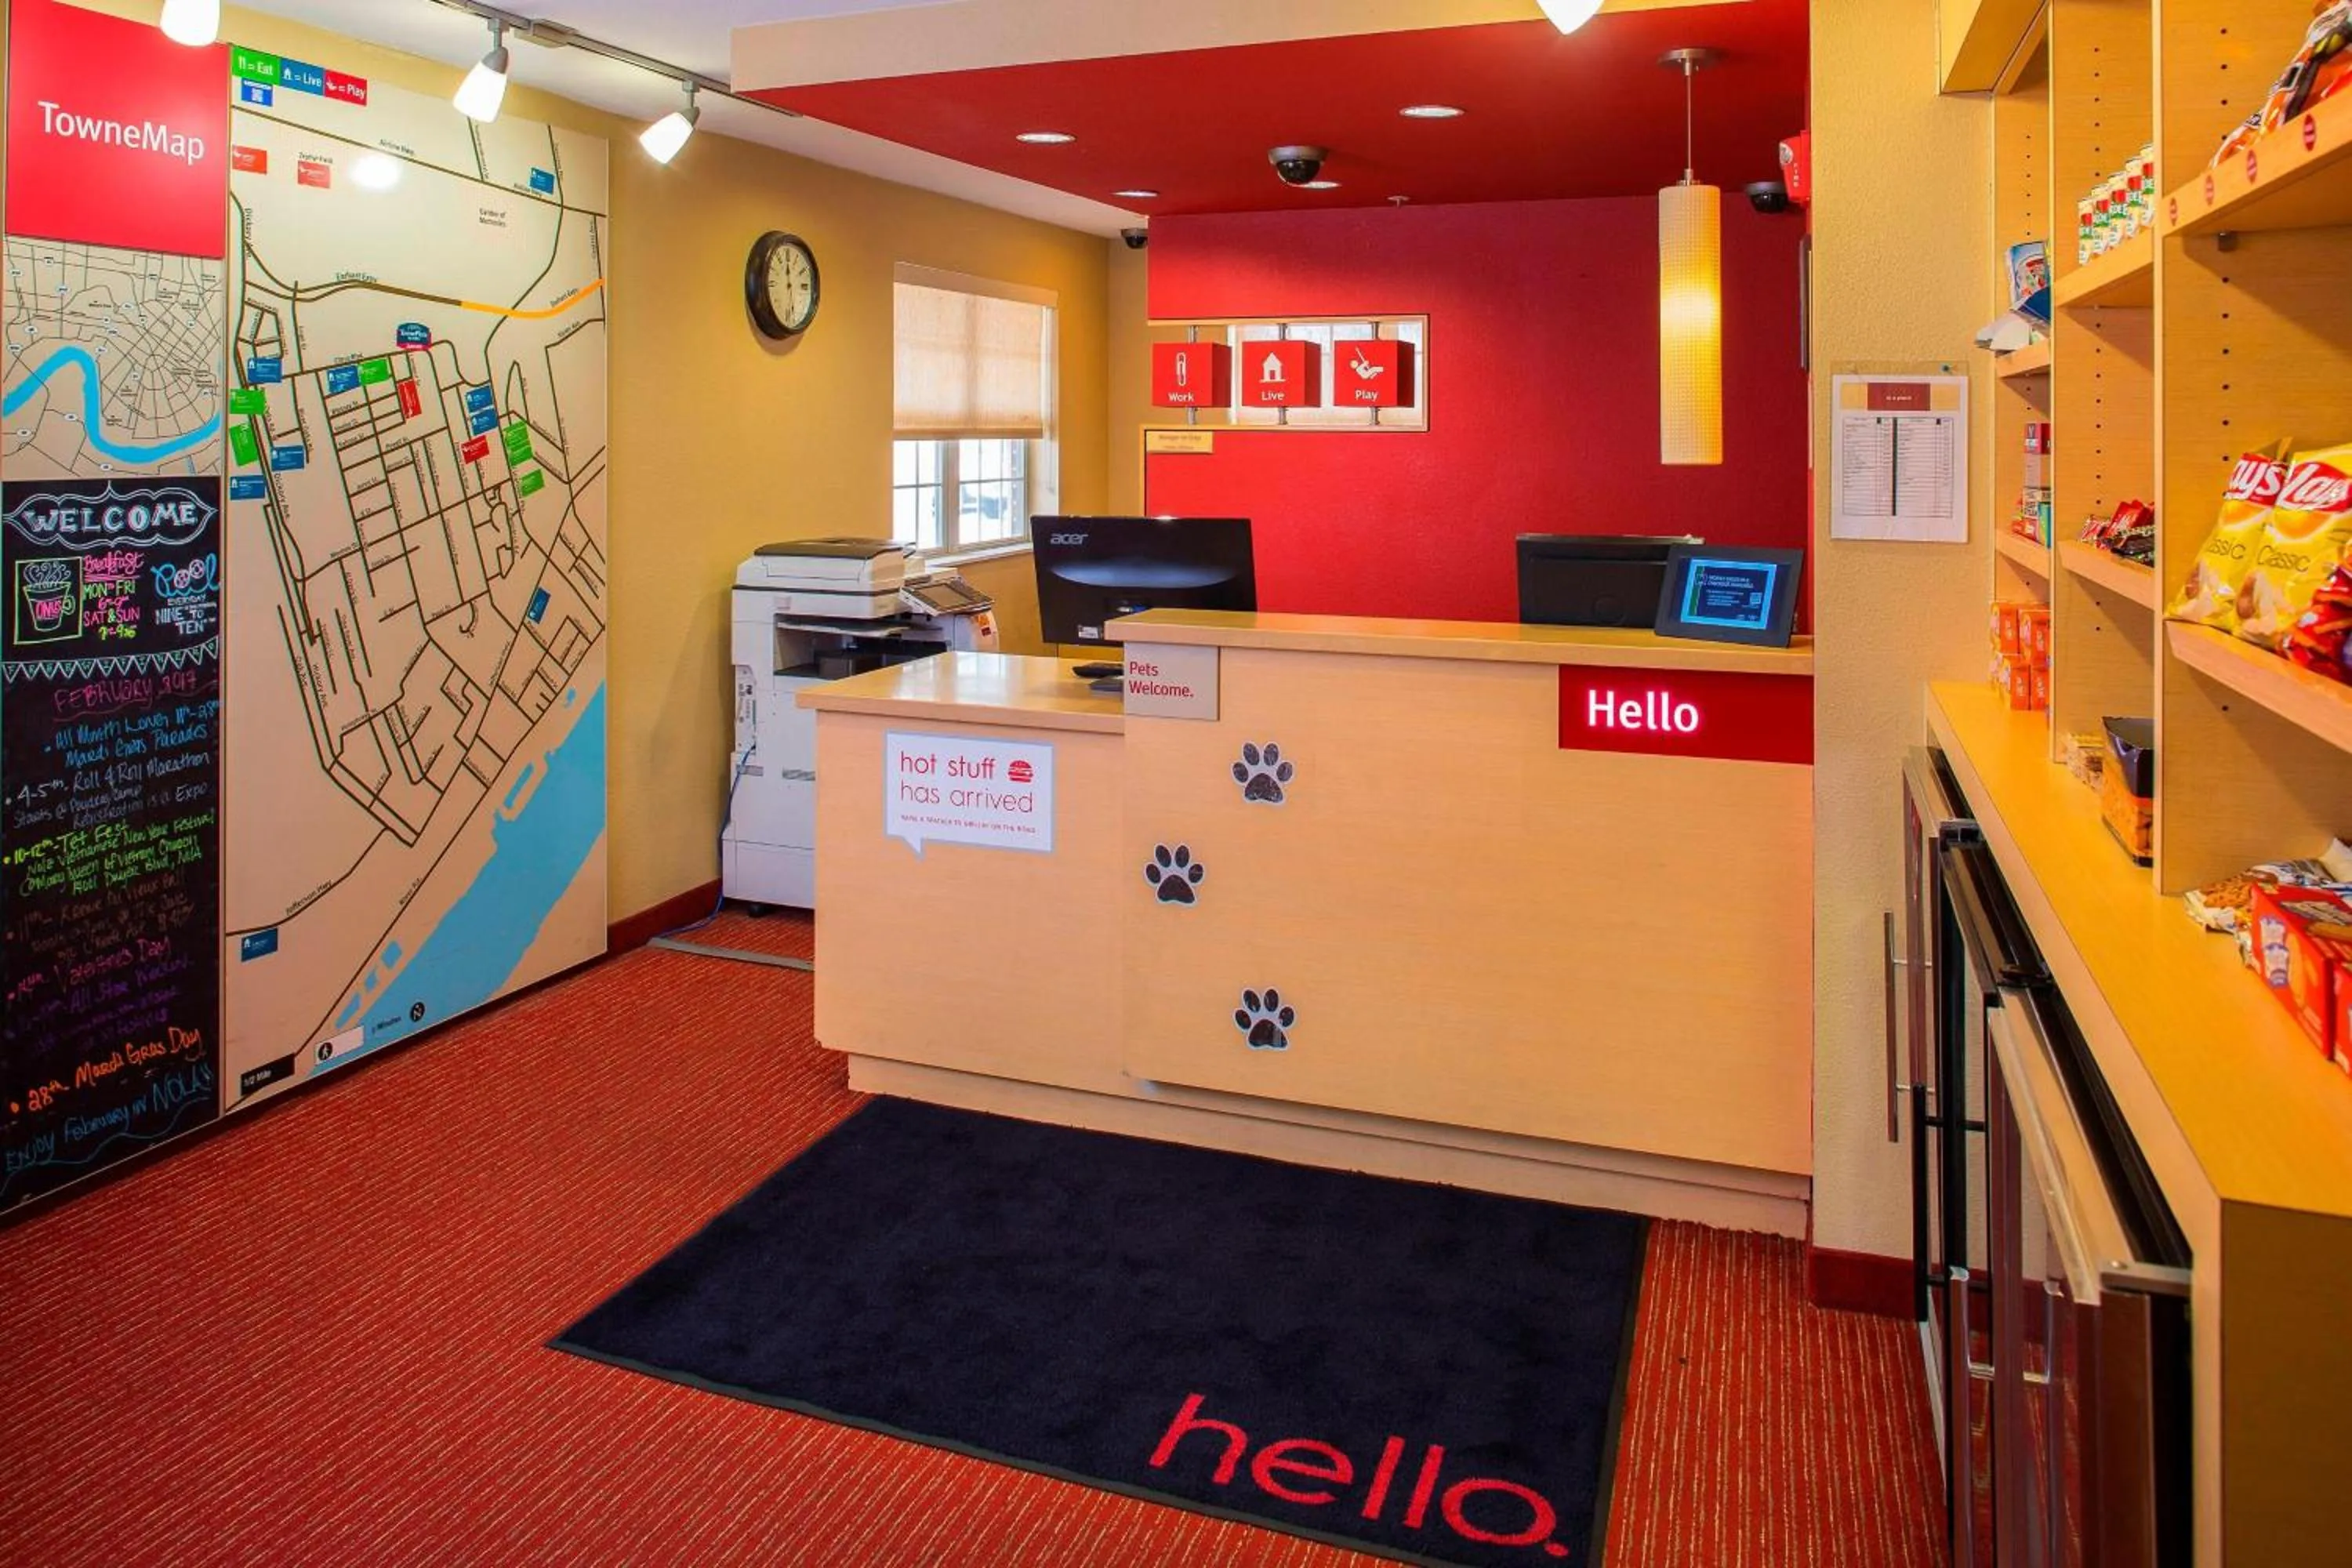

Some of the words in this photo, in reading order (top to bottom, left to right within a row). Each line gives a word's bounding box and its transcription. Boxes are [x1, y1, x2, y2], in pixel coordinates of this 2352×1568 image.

[257, 61, 273, 76] Eat
[303, 72, 321, 88] Live
[347, 83, 365, 100] Play
[38, 101, 205, 165] TowneMap
[1168, 391, 1194, 402] Work
[1261, 390, 1285, 401] Live
[1355, 389, 1378, 401] Play
[21, 501, 197, 533] WELCOME
[1051, 533, 1088, 545] acer
[84, 550, 144, 575] Breakfast
[151, 553, 220, 598] Pool
[83, 582, 107, 600] MON
[115, 579, 136, 595] FRI
[83, 611, 107, 627] SAT
[107, 608, 117, 622] &
[116, 606, 140, 623] SUN
[175, 619, 205, 634] TEN
[1129, 661, 1159, 677] Pets
[53, 678, 153, 712] FEBRUARY
[159, 670, 198, 694] 2017
[1129, 681, 1194, 698] Welcome.
[1588, 690, 1700, 733] Hello
[147, 752, 210, 779] Marathon
[901, 751, 936, 775] hot
[948, 756, 996, 779] stuff
[176, 782, 207, 803] Expo
[901, 779, 940, 804] has
[950, 787, 1033, 813] arrived
[94, 818, 130, 843] Fest
[285, 891, 317, 916] Jefferson
[75, 1051, 125, 1090] Mardi
[125, 1040, 168, 1066] Gras
[167, 1025, 208, 1062] Day
[1148, 1392, 1570, 1558] hello.
